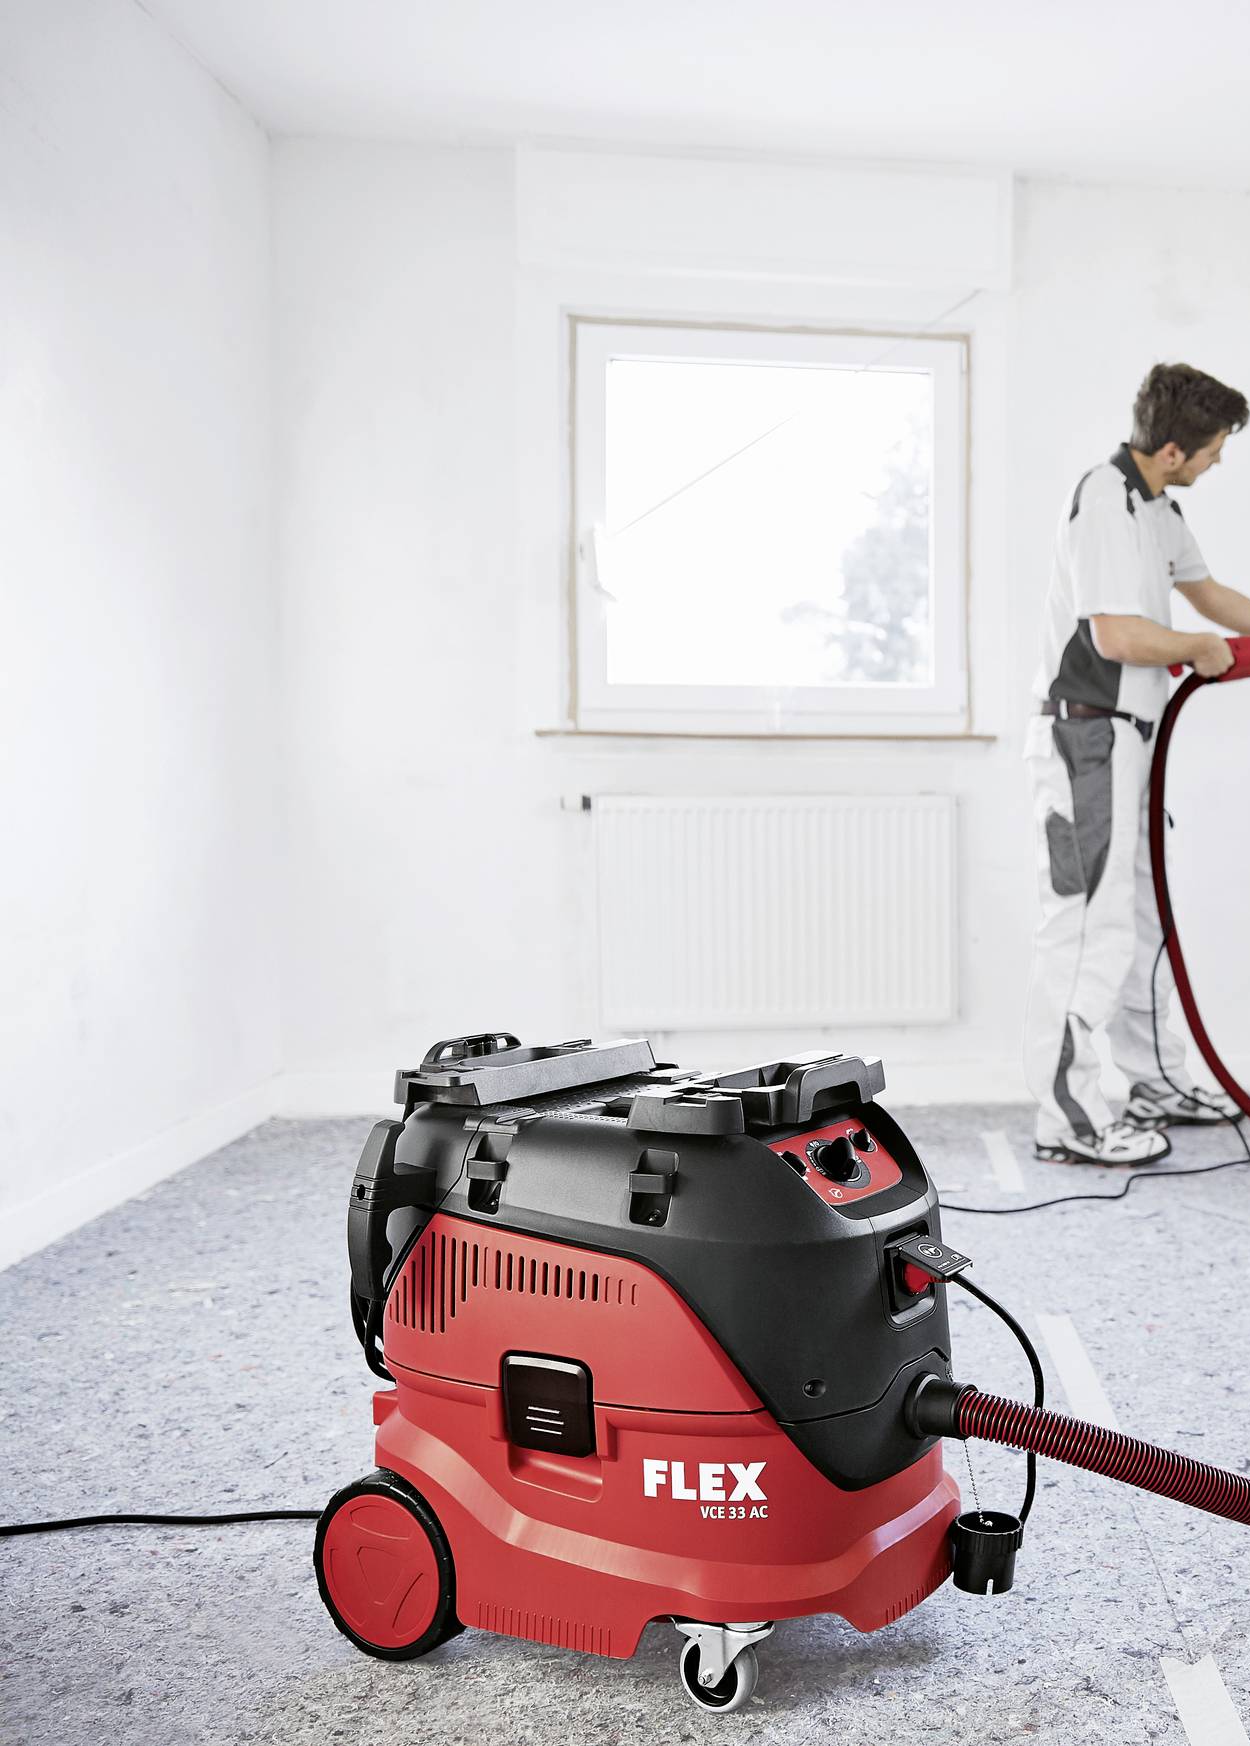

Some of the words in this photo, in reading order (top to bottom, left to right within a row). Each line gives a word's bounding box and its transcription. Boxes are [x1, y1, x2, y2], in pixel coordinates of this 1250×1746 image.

[643, 1458, 768, 1502] FLEX
[700, 1505, 725, 1519] VCE
[728, 1506, 746, 1519] 33
[749, 1505, 768, 1519] AC
